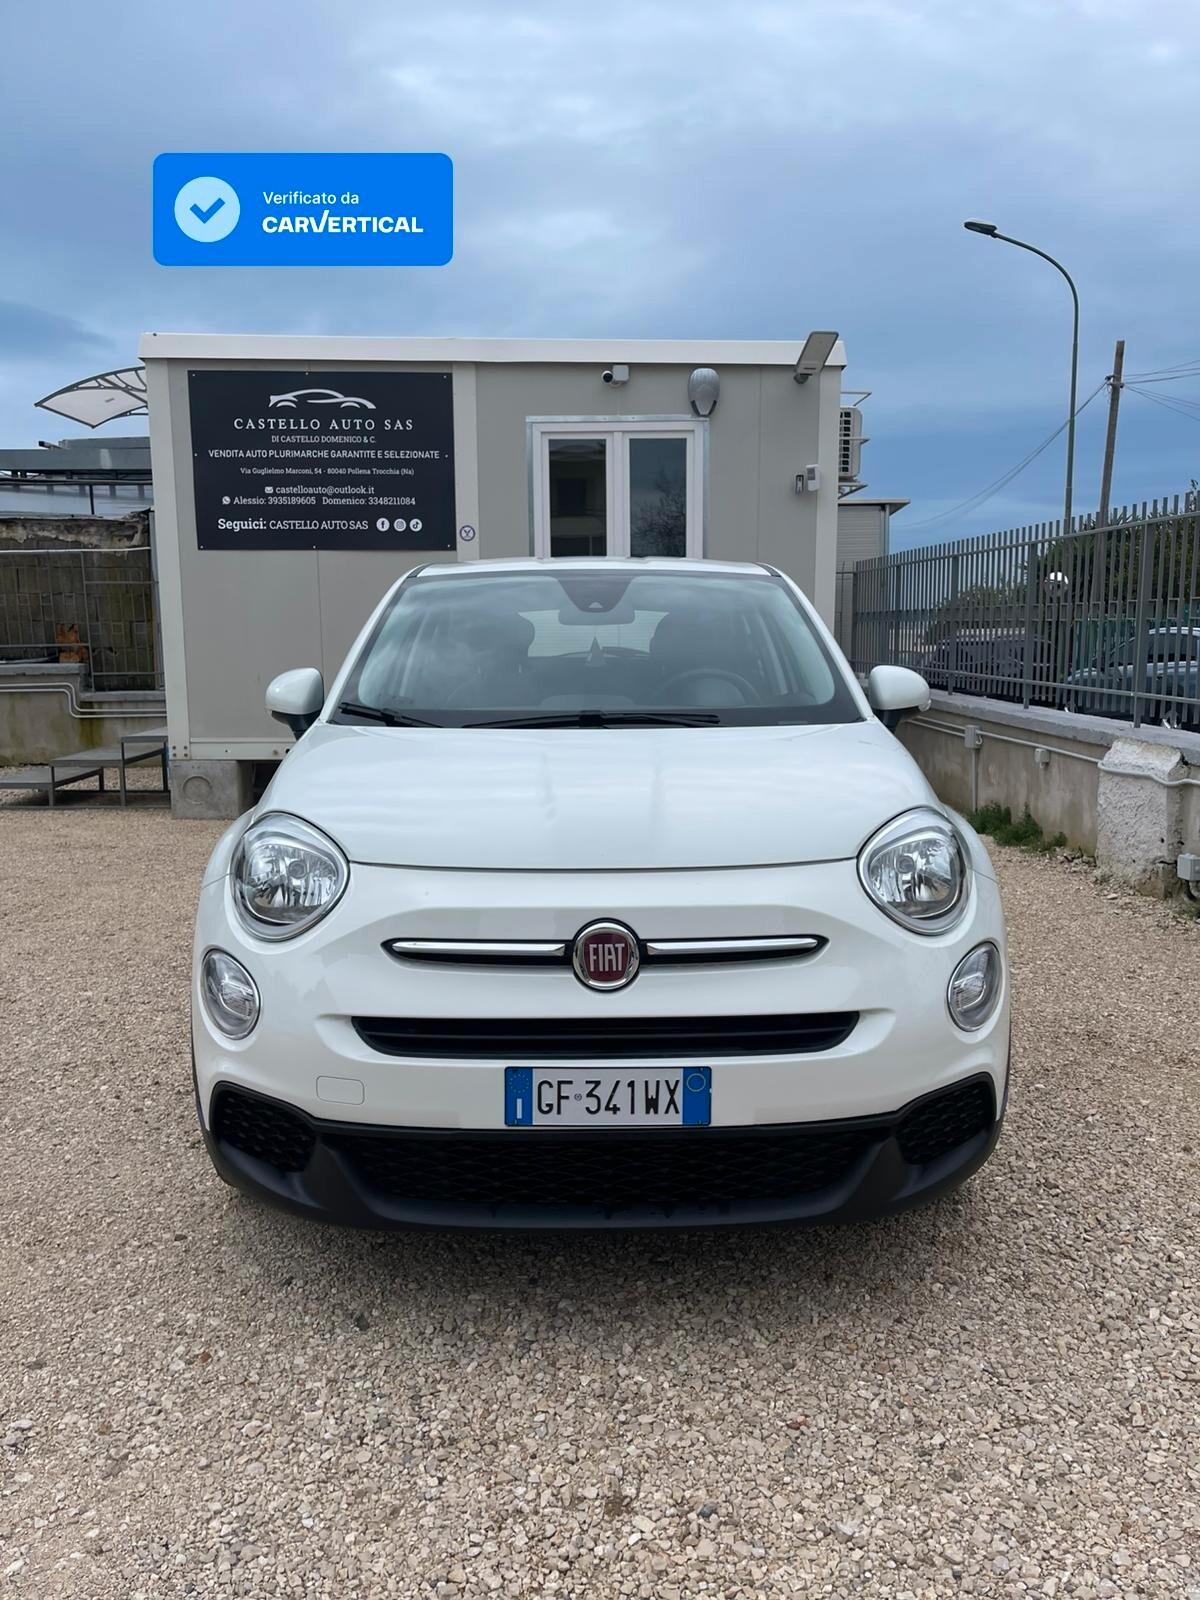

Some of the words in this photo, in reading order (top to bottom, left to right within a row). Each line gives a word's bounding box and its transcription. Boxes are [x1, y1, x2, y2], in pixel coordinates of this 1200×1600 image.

[233, 418, 321, 430] CASTELLO
[329, 419, 375, 430] AUTO
[384, 419, 413, 430] SAS
[271, 435, 280, 443] DI
[280, 435, 320, 443] CASTELLO
[321, 435, 362, 444] DOMENICO
[208, 449, 244, 458] VENDITA
[245, 449, 268, 458] AUTO
[268, 449, 329, 459] PLURIMARCHE
[330, 450, 376, 459] GARANTITE
[377, 450, 383, 459] E
[384, 450, 440, 459] SELEZIONATE
[240, 467, 251, 475] Via
[252, 467, 285, 476] Guglielmo
[285, 467, 314, 475] Marconi,
[327, 467, 347, 475] 80040
[347, 467, 371, 475] Pollena
[371, 467, 400, 475] Trocchia
[400, 468, 415, 476] (Na)
[275, 484, 375, 496] castelloauto@outlook.it
[233, 495, 267, 505] Alessio:
[267, 496, 317, 505] 3935189605
[322, 496, 367, 505] Domenico:
[368, 497, 416, 505] 3348211084
[217, 518, 267, 532] Seguici:
[269, 520, 319, 530] CASTELLO
[320, 520, 348, 530] AUTO
[349, 520, 369, 530] SAS
[588, 943, 626, 972] FIAT
